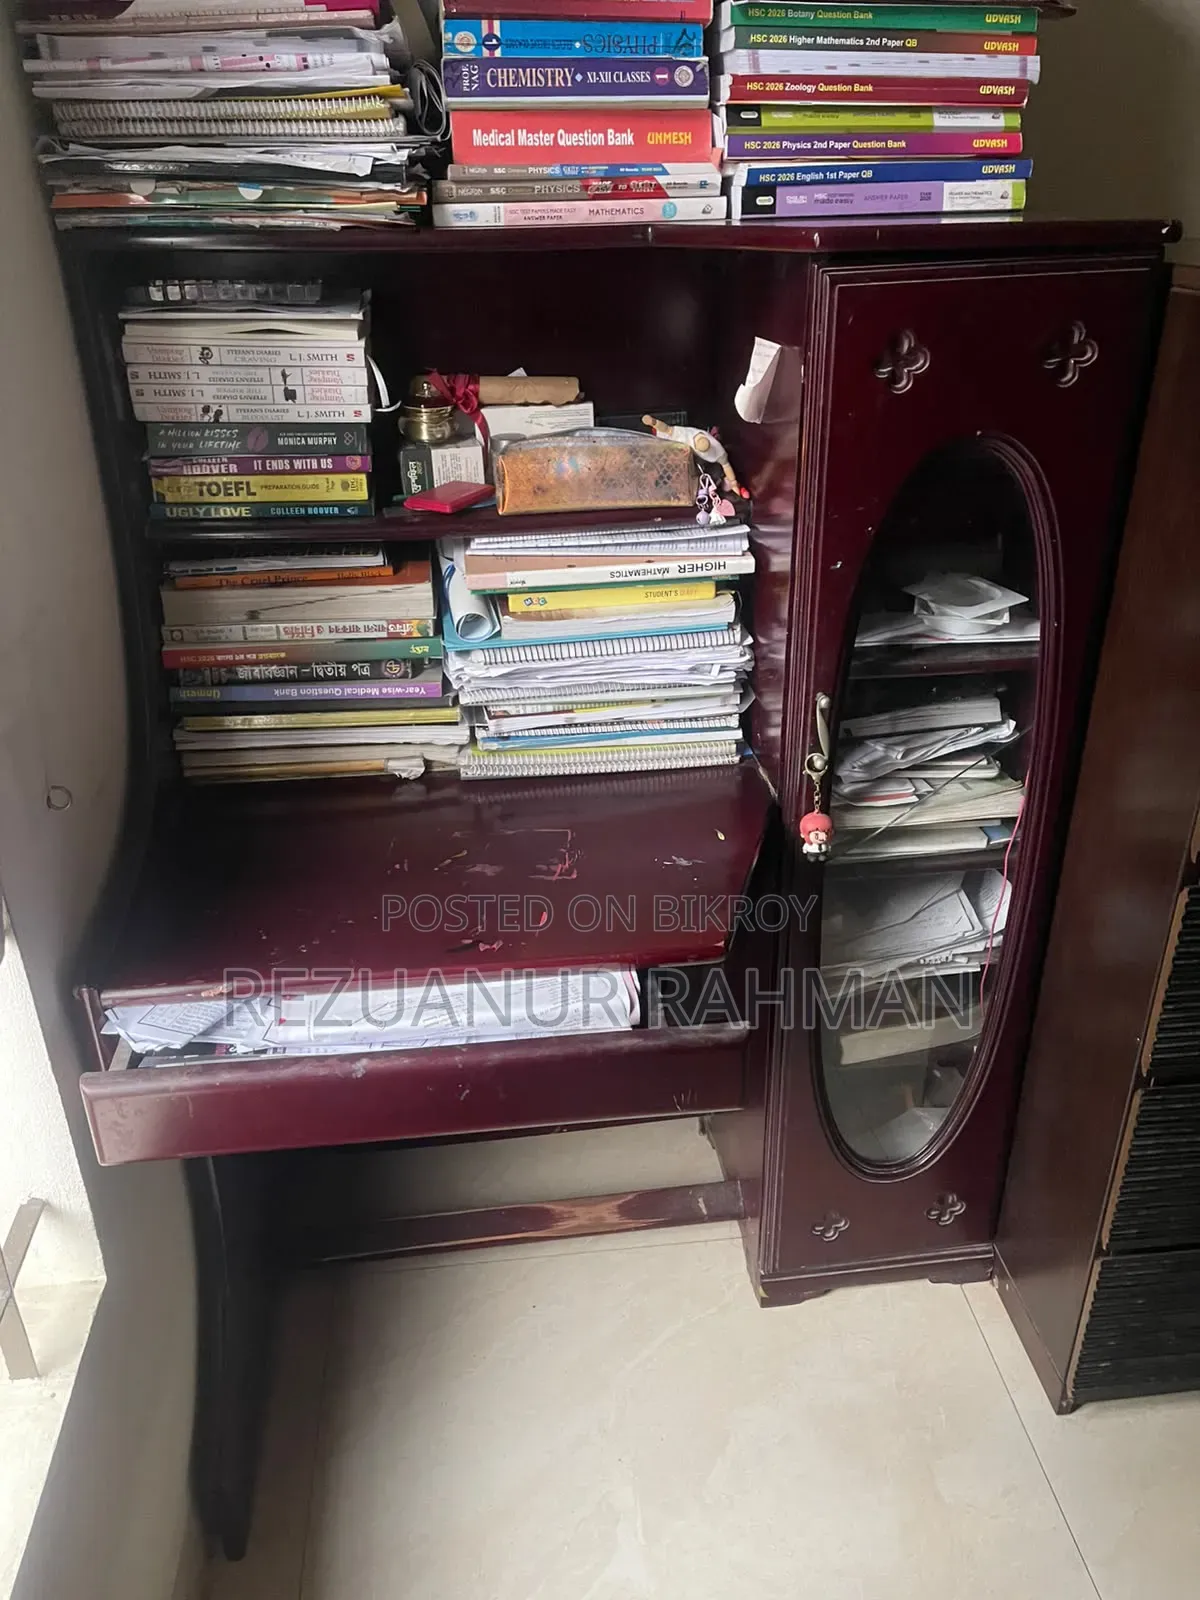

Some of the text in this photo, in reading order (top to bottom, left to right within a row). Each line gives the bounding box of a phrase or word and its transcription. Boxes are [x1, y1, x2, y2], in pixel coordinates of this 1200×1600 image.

[748, 8, 873, 20] HSC 2026 Botany Question Bank
[985, 14, 1021, 24] UDVASH
[582, 33, 657, 54] PHYSICS
[750, 34, 918, 49] HSC 2026 Higher Mathematics 2nd Paper QB
[984, 41, 1019, 52] UDVASH
[462, 63, 480, 92] PROF. NAG
[486, 67, 576, 88] CHEMISTRY
[613, 71, 651, 82] CLASSES
[747, 82, 873, 94] HSC 2026 Zoology Question Bank
[980, 85, 1015, 95] UDVASH
[472, 129, 634, 147] Medical Master Question Bank
[647, 132, 692, 145] UNMESH
[973, 138, 1008, 148] UDVASH
[744, 139, 906, 151] HSC 2026 Physics 2nd Paper Question Bank
[528, 166, 560, 174] PHYSICS
[982, 164, 1016, 174] UDVASH
[759, 170, 873, 183] HSC 2026 English 1st Paper QB
[490, 187, 507, 195] SSC
[534, 184, 581, 194] PHYSICS
[589, 207, 645, 216] MATHEMATICS
[233, 355, 277, 363] CRAVING
[307, 353, 338, 361] SMITH
[148, 371, 181, 380] SMITH
[153, 389, 186, 397] SMITH
[315, 410, 345, 418] SMITH
[168, 428, 201, 437] MILLION
[204, 429, 239, 438] KISSES
[200, 441, 242, 451] LIFETIME
[278, 437, 337, 445] MONICA MURPHY
[183, 464, 238, 475] HOOVER
[253, 458, 333, 471] IT ENDS WITH US
[195, 480, 257, 497] TOEFL
[165, 506, 252, 518] UGLY LOVE
[270, 507, 339, 515] COLLEEN HOOVER
[609, 561, 726, 578] HIGHER MATHEMATICS
[217, 574, 308, 586] The Cruel Prince
[644, 590, 679, 598] STUDENT'S
[317, 625, 324, 633] ও
[351, 662, 371, 677] পত্র
[183, 689, 221, 699] Unmesh
[273, 686, 426, 697] Year-wise Medical Question Bank
